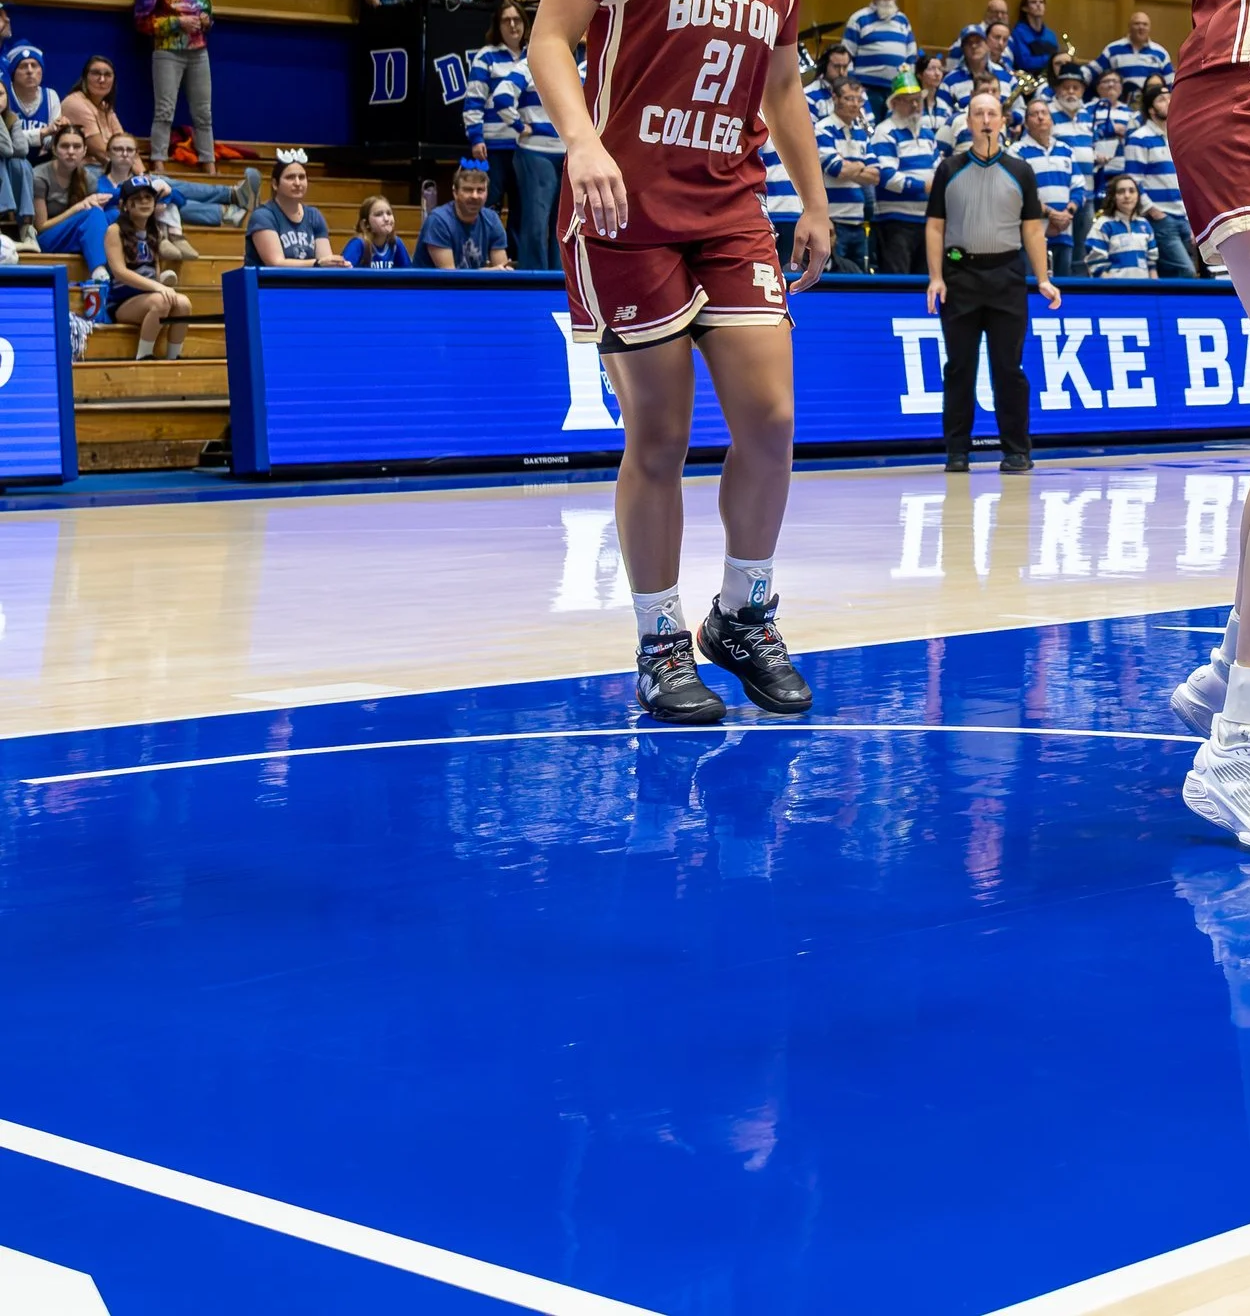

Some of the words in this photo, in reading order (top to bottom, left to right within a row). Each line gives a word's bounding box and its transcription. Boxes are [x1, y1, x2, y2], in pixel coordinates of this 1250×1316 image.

[369, 48, 408, 105] D
[692, 38, 746, 105] 21
[638, 105, 743, 155] COLLEG
[523, 456, 569, 465] DAKTRONICS
